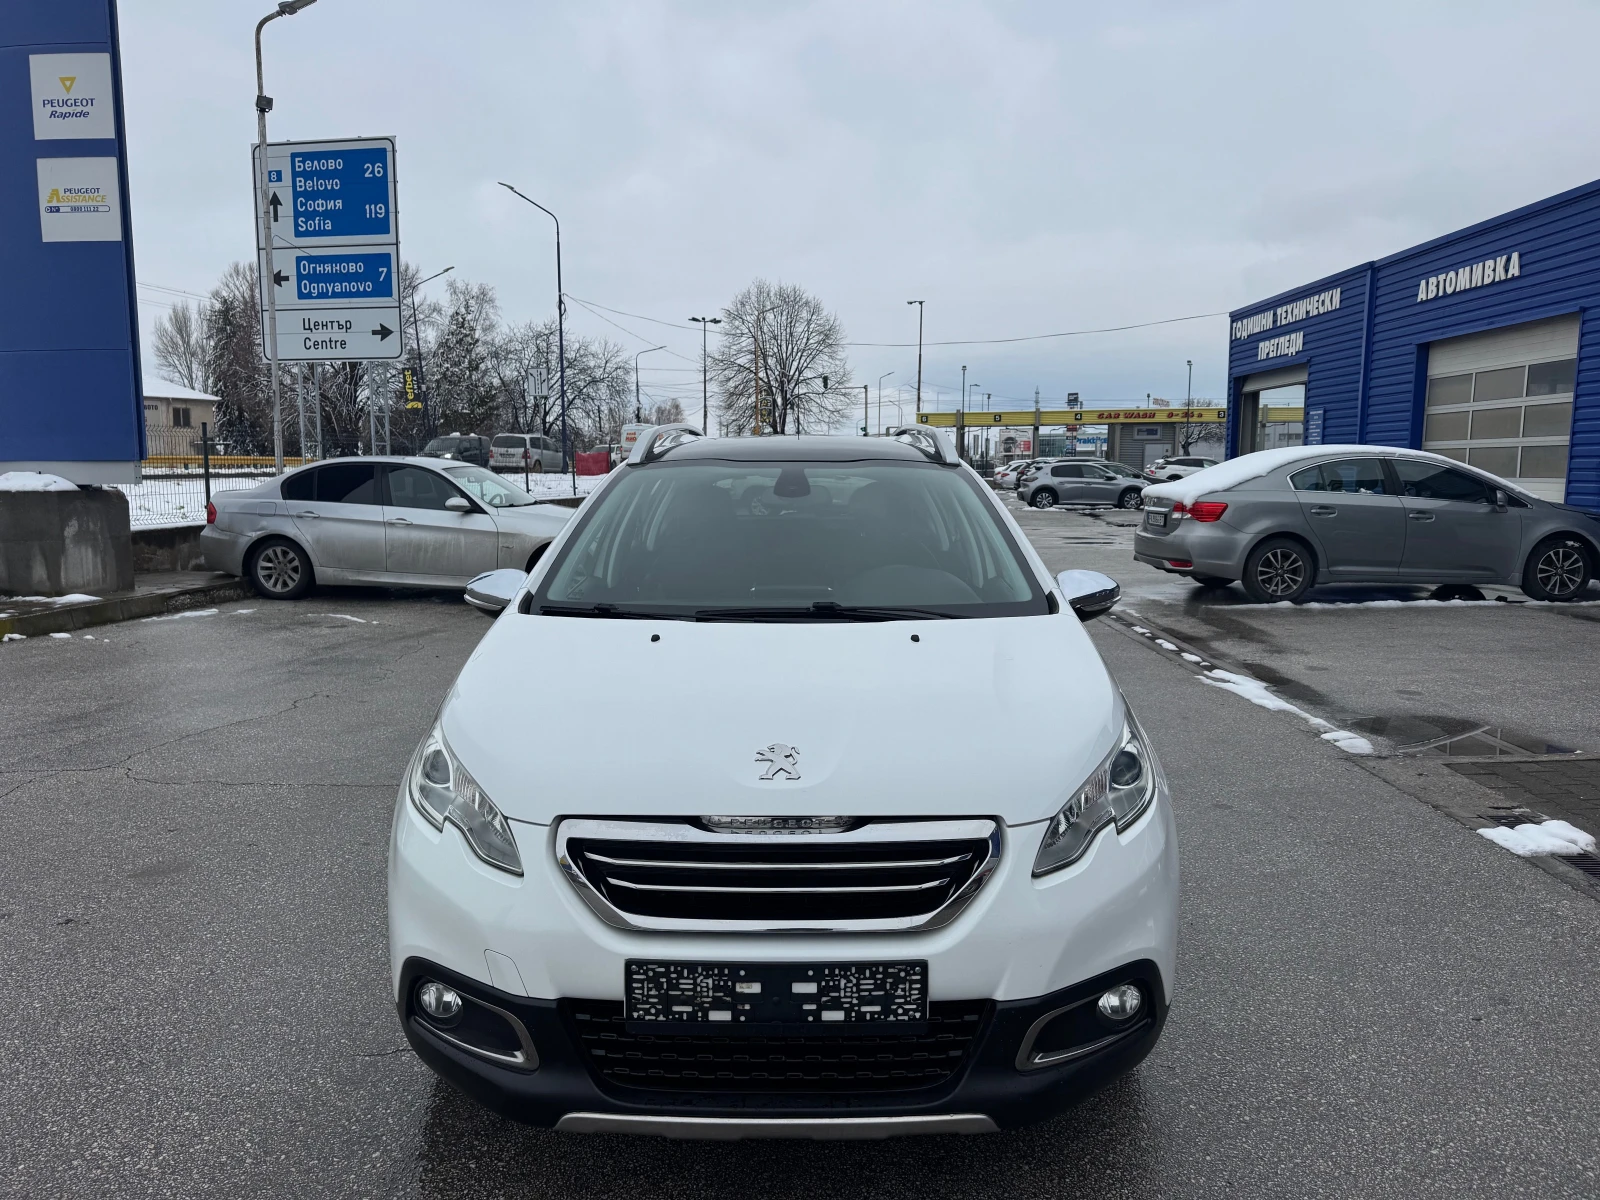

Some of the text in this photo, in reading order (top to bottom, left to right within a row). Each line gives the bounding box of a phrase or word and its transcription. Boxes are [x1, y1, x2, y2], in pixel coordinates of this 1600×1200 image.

[42, 98, 95, 108] PEUGEOT
[49, 109, 90, 120] Rapide
[295, 157, 384, 178] Белово 26
[270, 171, 277, 182] 8
[63, 187, 101, 195] PEUGEOT
[296, 177, 341, 192] Belovo
[297, 198, 386, 219] София 119
[298, 217, 332, 231] Sofia
[300, 261, 388, 281] Огняново 7
[1417, 251, 1520, 303] АВТОМИВКА
[301, 280, 373, 296] Ognyanovo
[1231, 287, 1341, 340] ГОДИШНИ ТЕХНИЧЕСКИ
[302, 318, 352, 333] Център
[303, 337, 347, 350] Centre
[1257, 331, 1304, 361] ПРЕГЛЕДИ
[1097, 412, 1121, 420] CAR
[1123, 411, 1156, 419] WASH
